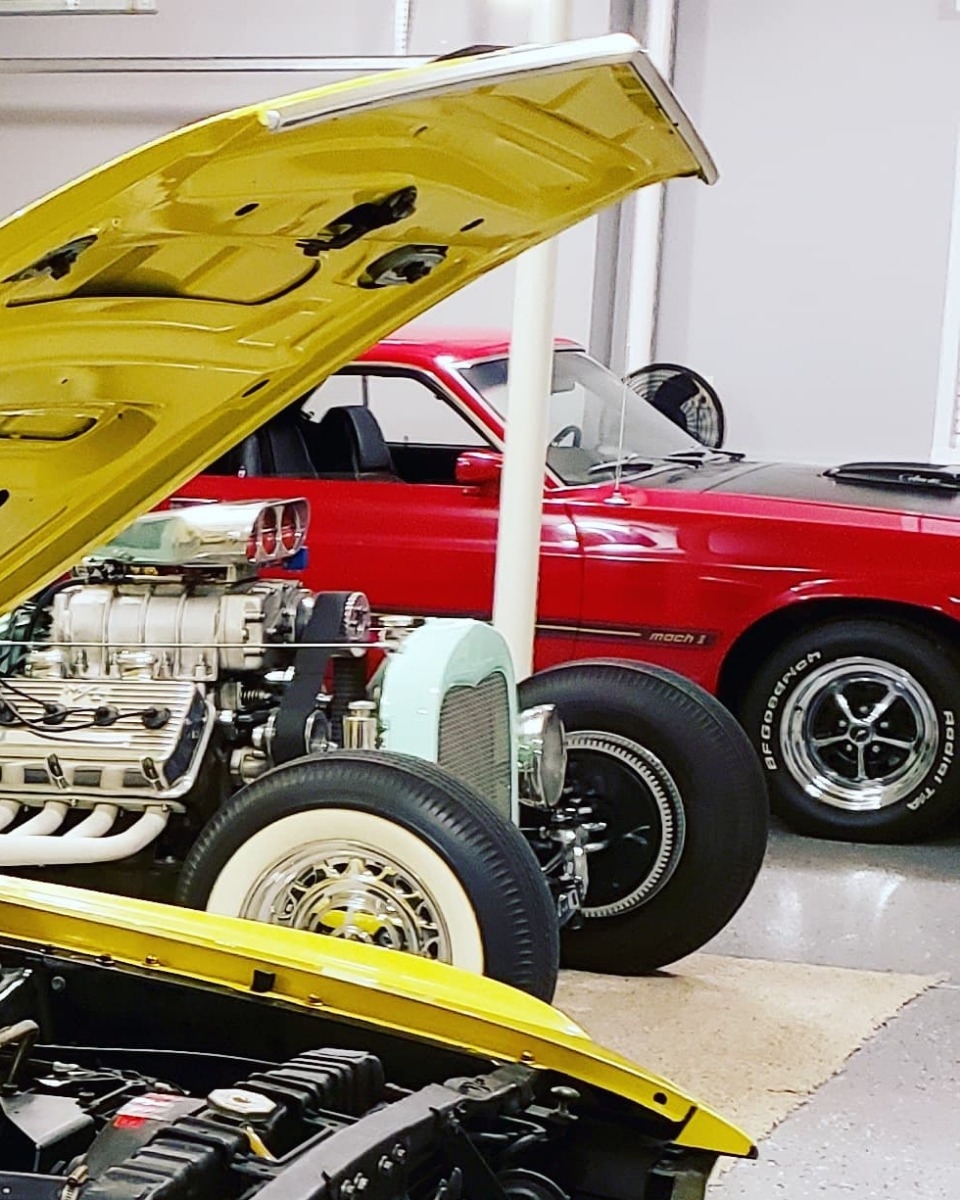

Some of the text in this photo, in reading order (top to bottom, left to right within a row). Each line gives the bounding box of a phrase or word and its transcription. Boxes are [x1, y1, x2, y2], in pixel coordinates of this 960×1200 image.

[649, 632, 694, 644] mach
[761, 651, 821, 770] BFGoodrich
[934, 710, 955, 784] Radial
